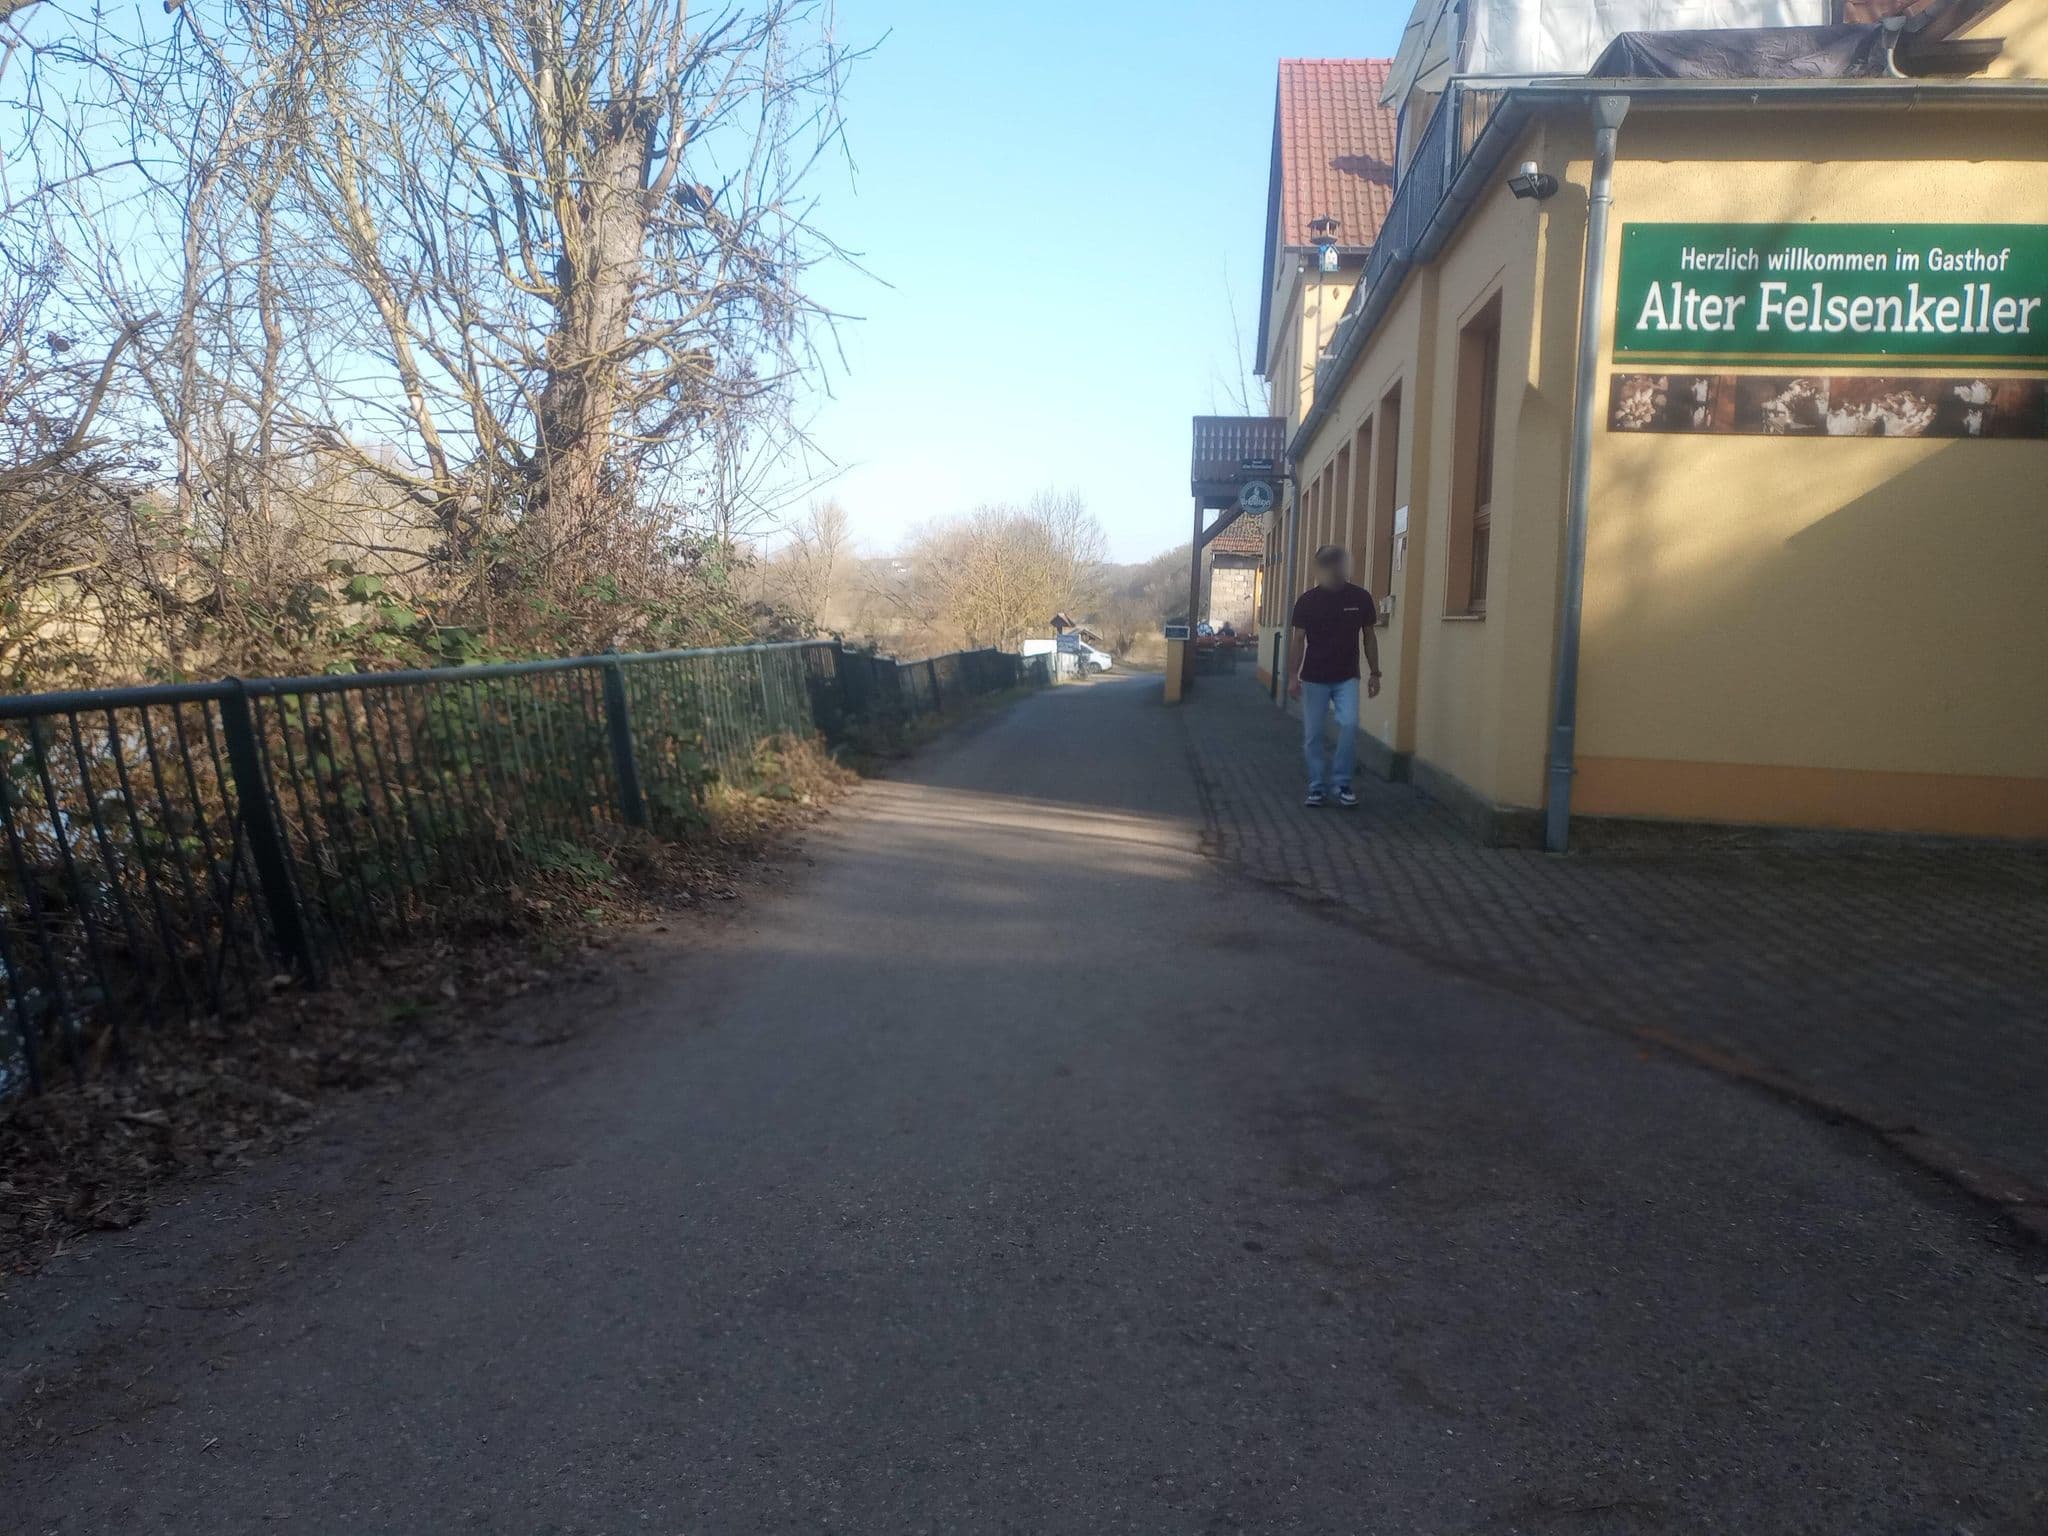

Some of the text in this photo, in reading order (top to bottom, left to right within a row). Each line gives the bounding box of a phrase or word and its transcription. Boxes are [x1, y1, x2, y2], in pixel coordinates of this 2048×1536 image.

[1681, 246, 2010, 272] Herzlich willkommen im Gasthof
[1635, 280, 2041, 333] Alter Felsenkeller
